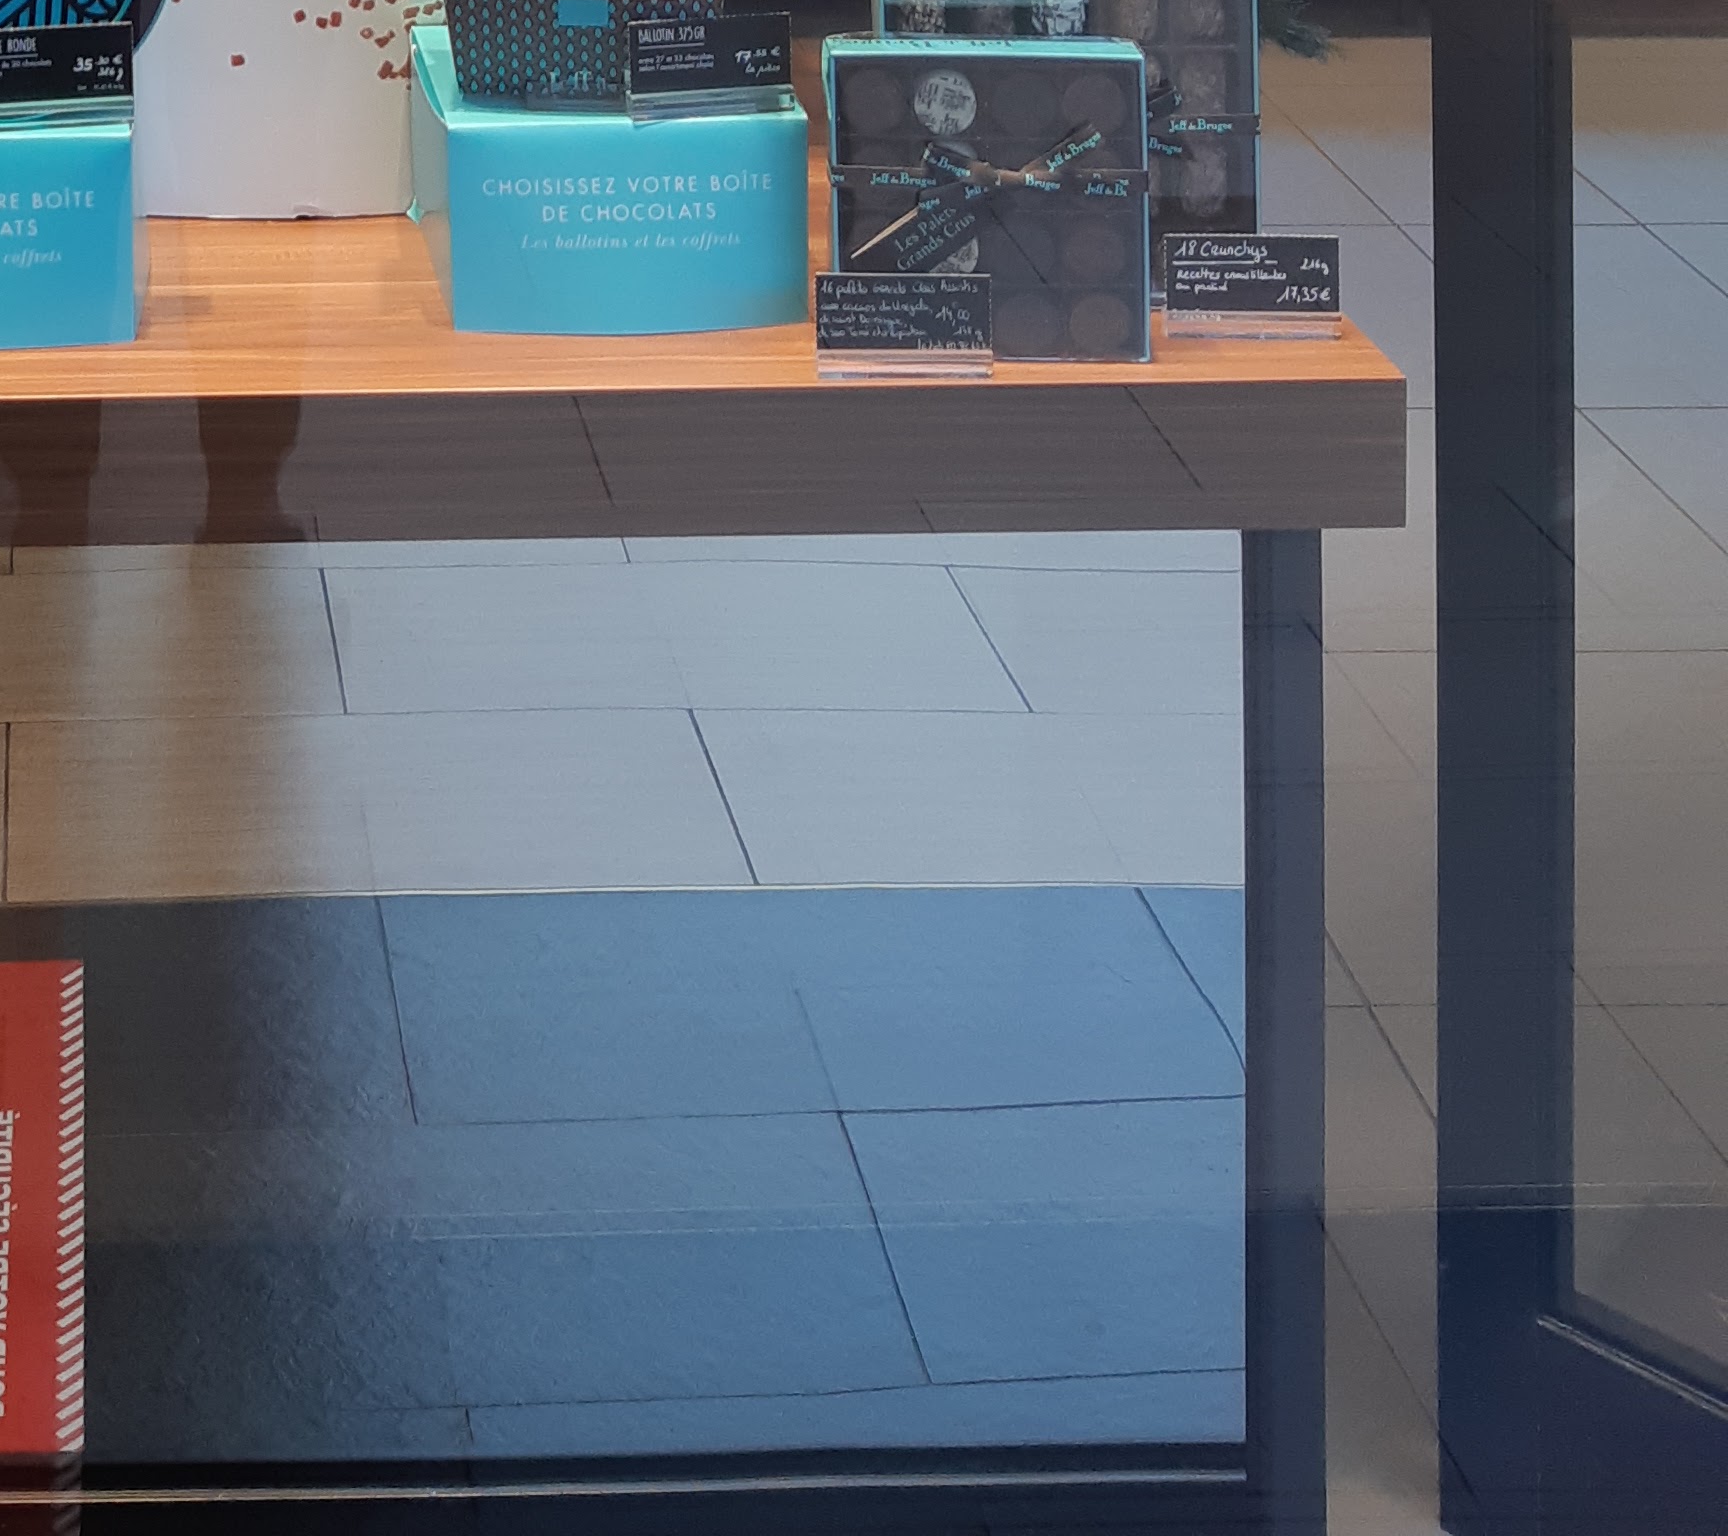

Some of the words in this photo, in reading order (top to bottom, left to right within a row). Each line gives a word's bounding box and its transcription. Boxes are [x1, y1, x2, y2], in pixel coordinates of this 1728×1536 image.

[482, 176, 616, 196] CHOISISSEZ
[628, 174, 697, 192] VOTRE
[710, 169, 772, 192] BOÎTE
[32, 187, 95, 209] BOÎTE
[542, 204, 569, 222] DE
[580, 201, 717, 222] CHOCOLATS
[1174, 240, 1197, 256] 18
